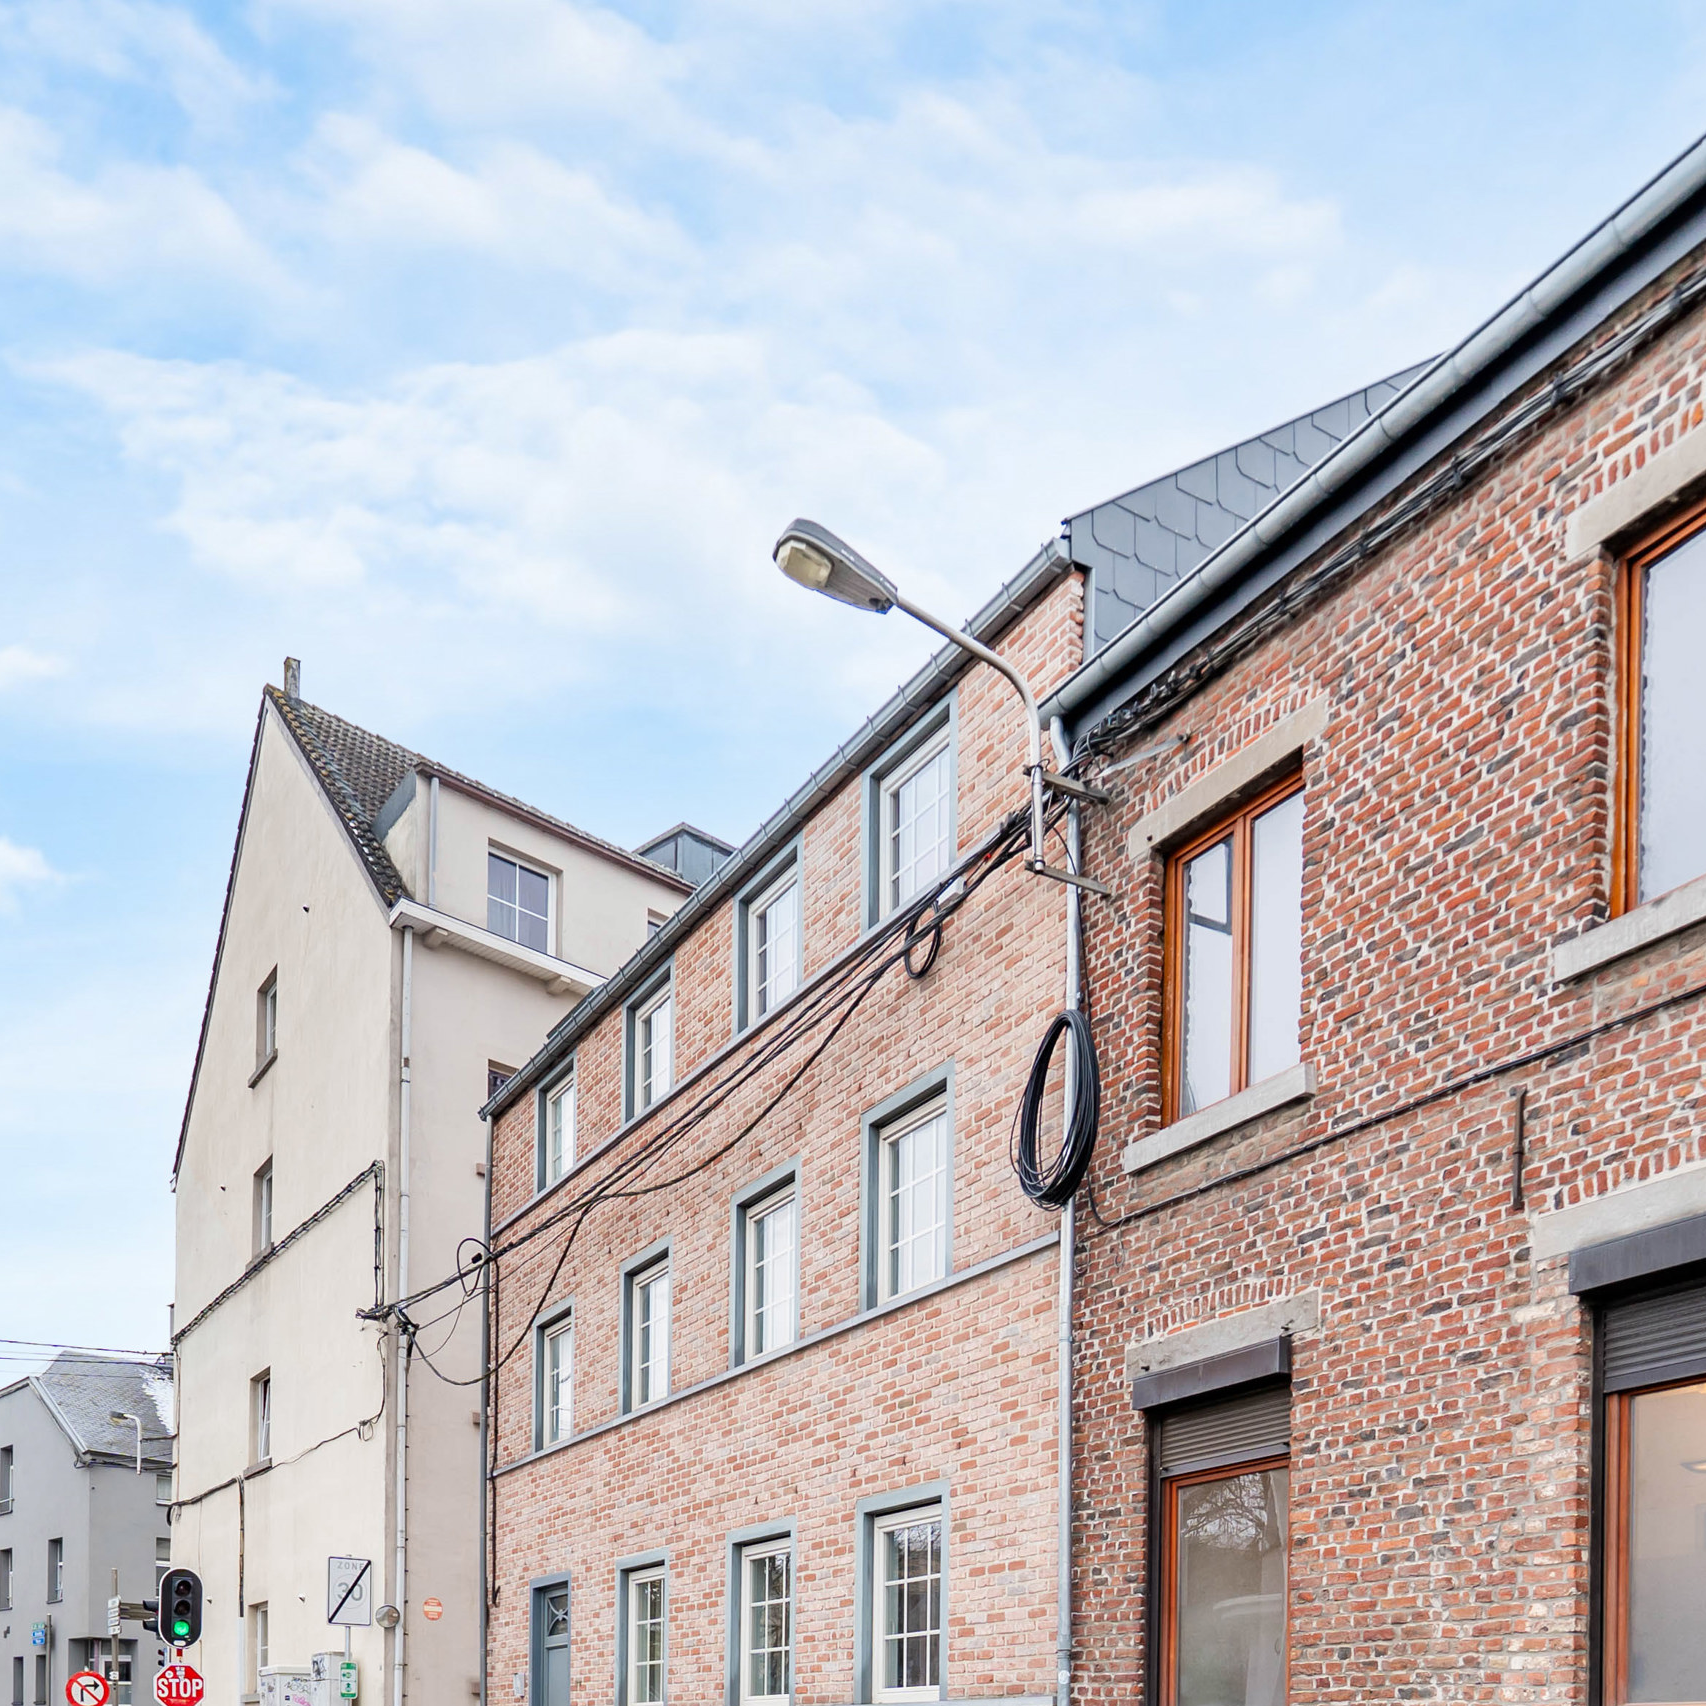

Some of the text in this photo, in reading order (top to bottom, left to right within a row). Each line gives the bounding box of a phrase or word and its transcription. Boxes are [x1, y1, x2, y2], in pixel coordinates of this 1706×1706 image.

[337, 1561, 364, 1570] ZONE
[337, 1582, 363, 1602] 30
[157, 1677, 203, 1698] STOP
